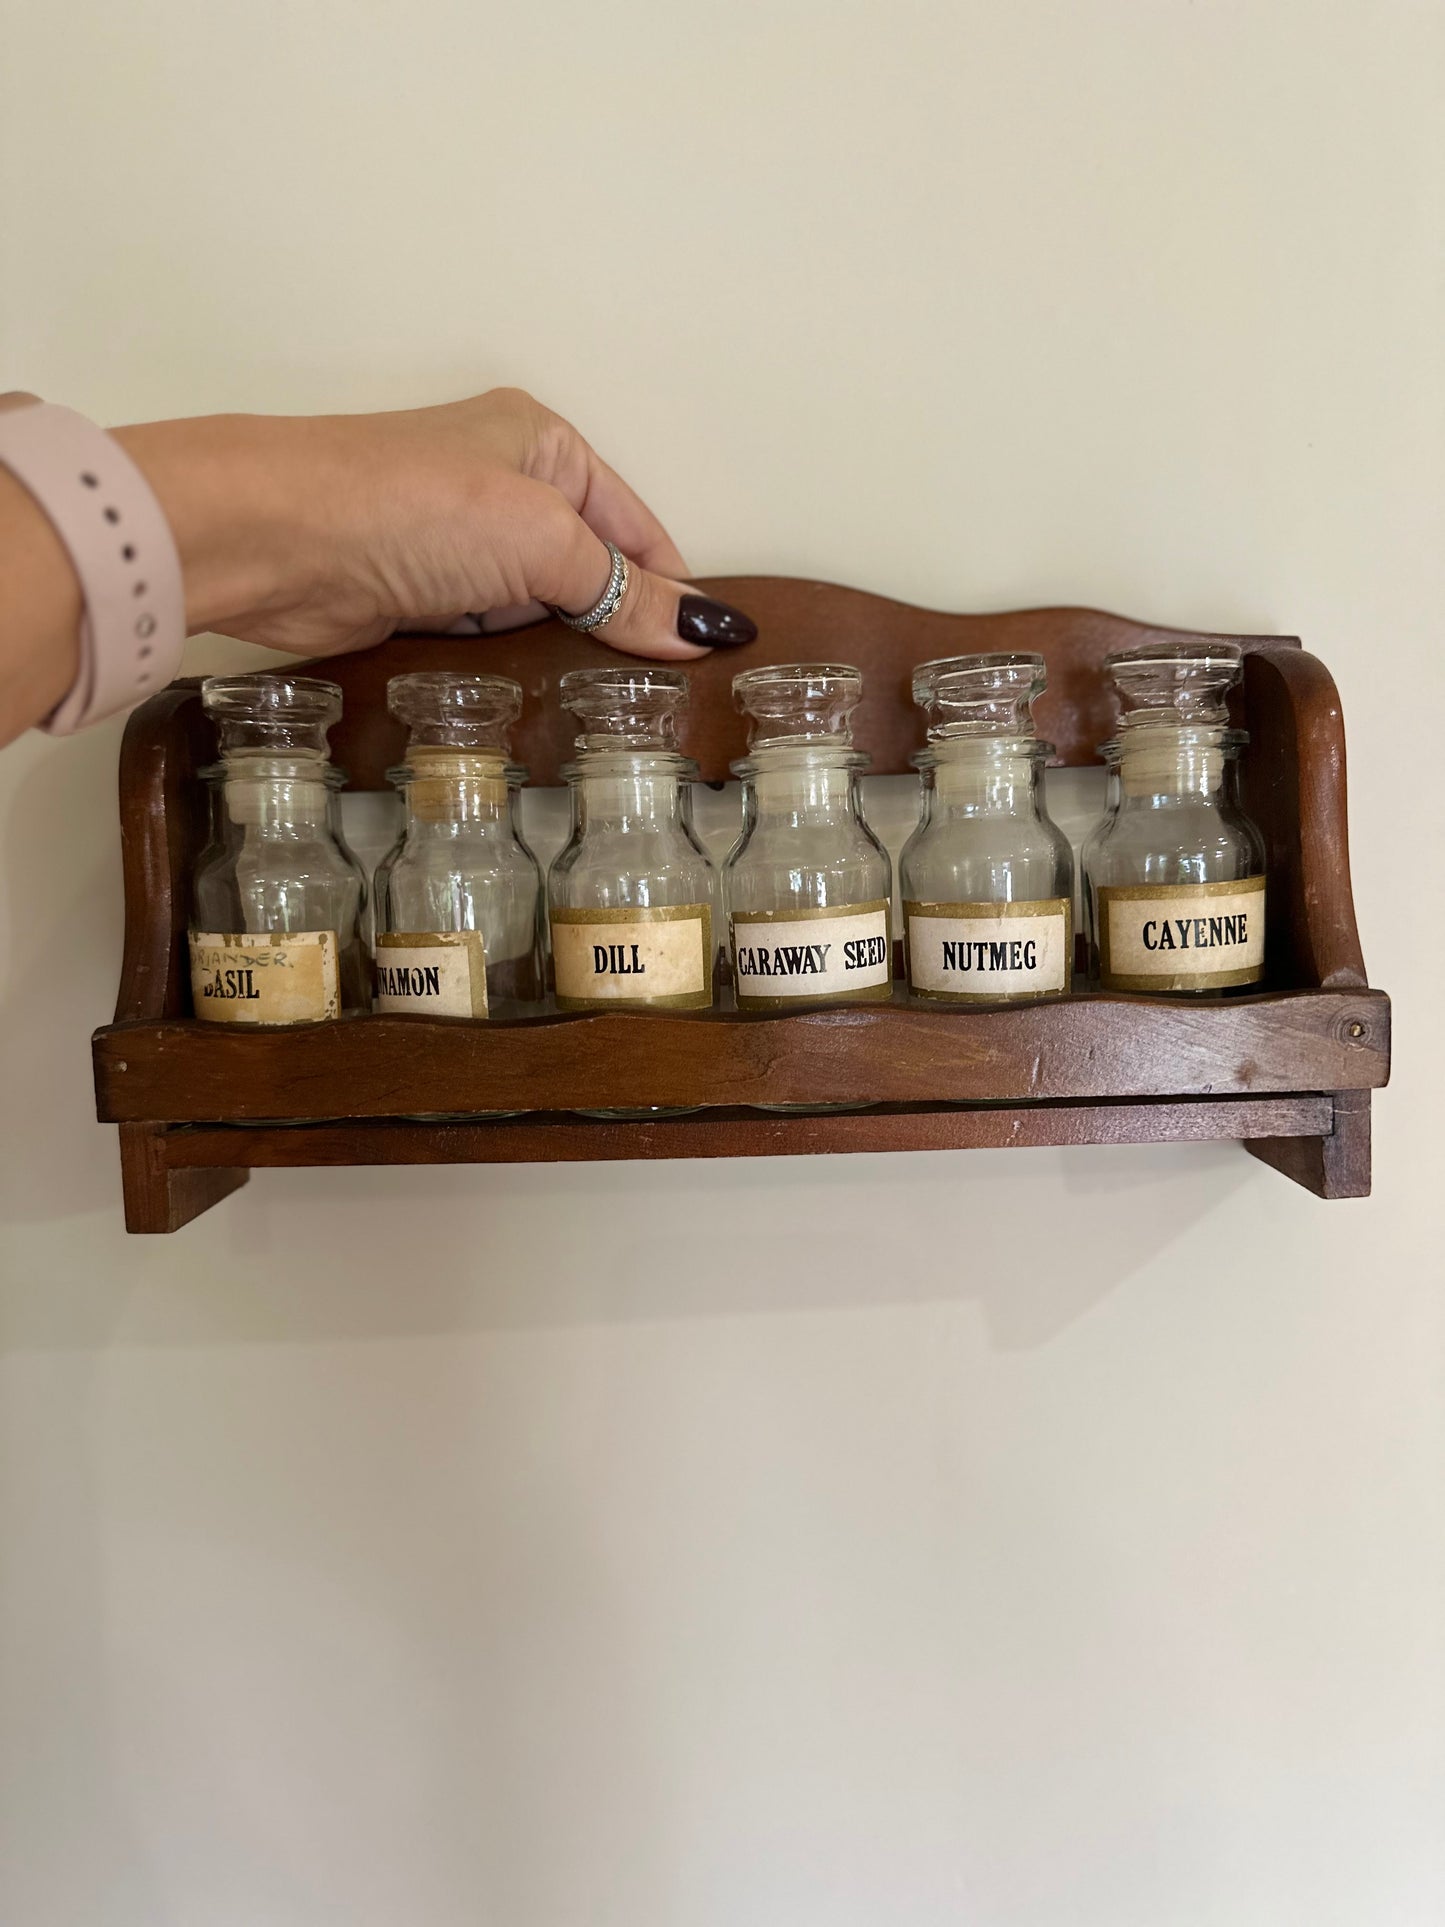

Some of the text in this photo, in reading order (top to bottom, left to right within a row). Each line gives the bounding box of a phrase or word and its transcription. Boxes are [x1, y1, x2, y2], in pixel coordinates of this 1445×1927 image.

[1142, 913, 1248, 951] CAYENNE
[592, 944, 646, 974] DILL
[738, 936, 886, 976] CARAWAY SEED
[942, 940, 1037, 971] NUTMEG
